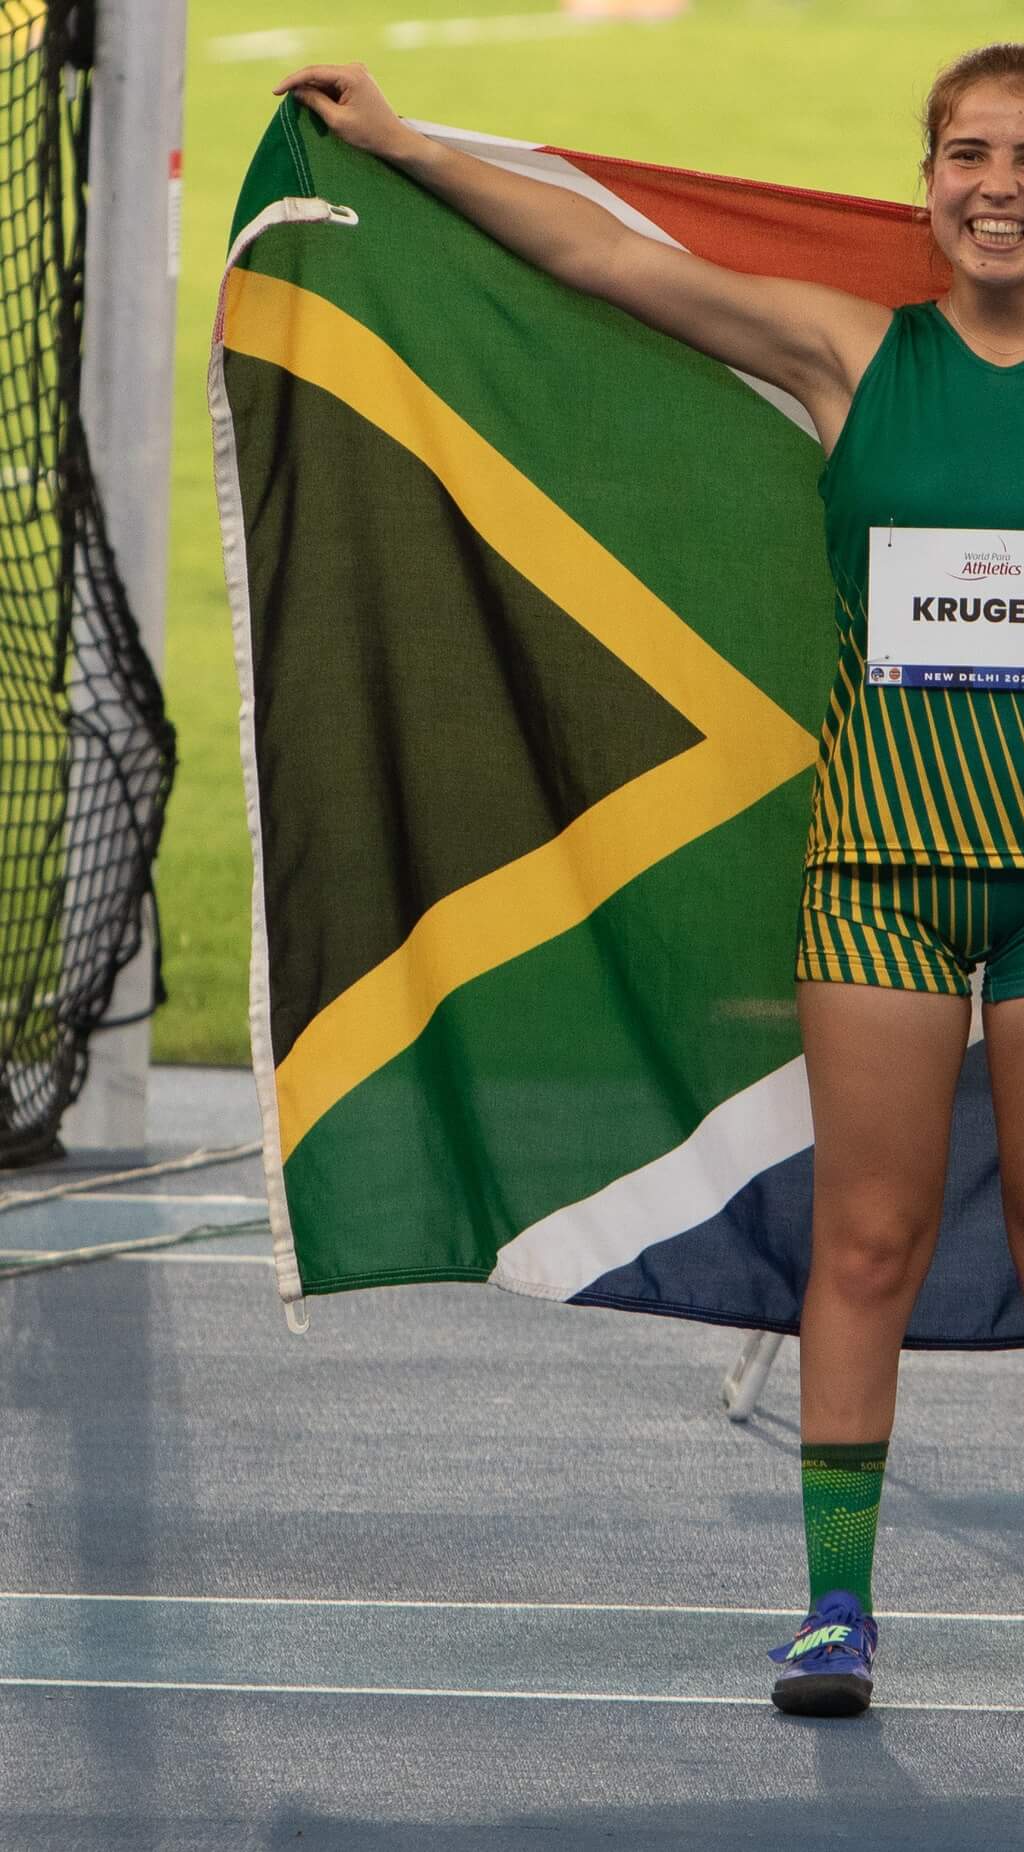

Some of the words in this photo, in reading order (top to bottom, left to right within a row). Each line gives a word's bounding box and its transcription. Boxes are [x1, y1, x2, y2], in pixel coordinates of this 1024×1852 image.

[964, 552, 990, 560] World
[962, 561, 1022, 576] Athletics
[924, 672, 953, 681] NEW
[959, 673, 999, 682] DELHI
[785, 1625, 852, 1660] NIKE
